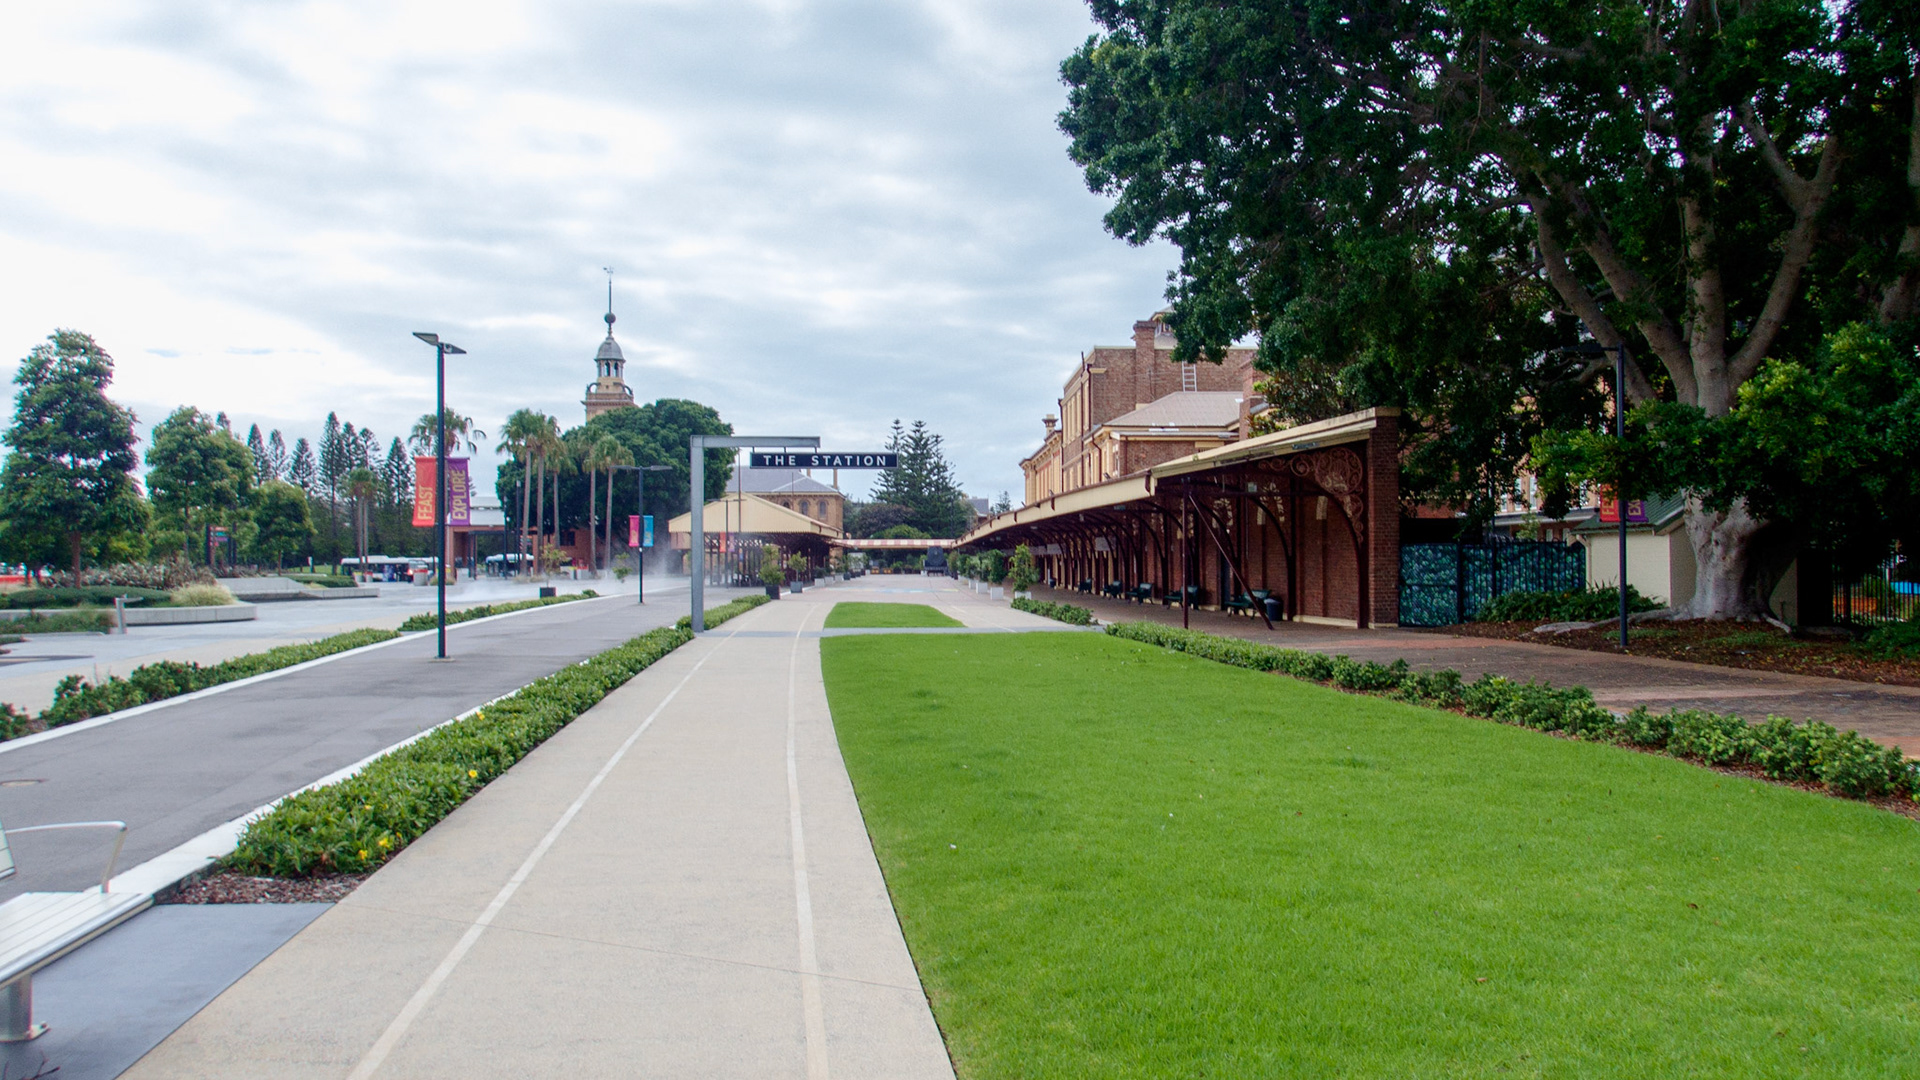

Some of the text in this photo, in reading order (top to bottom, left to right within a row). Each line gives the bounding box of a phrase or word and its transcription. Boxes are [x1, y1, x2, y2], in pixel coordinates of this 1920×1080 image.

[763, 455, 886, 467] THE STATION
[417, 485, 433, 520] FEAST
[452, 470, 468, 520] EXPLORE
